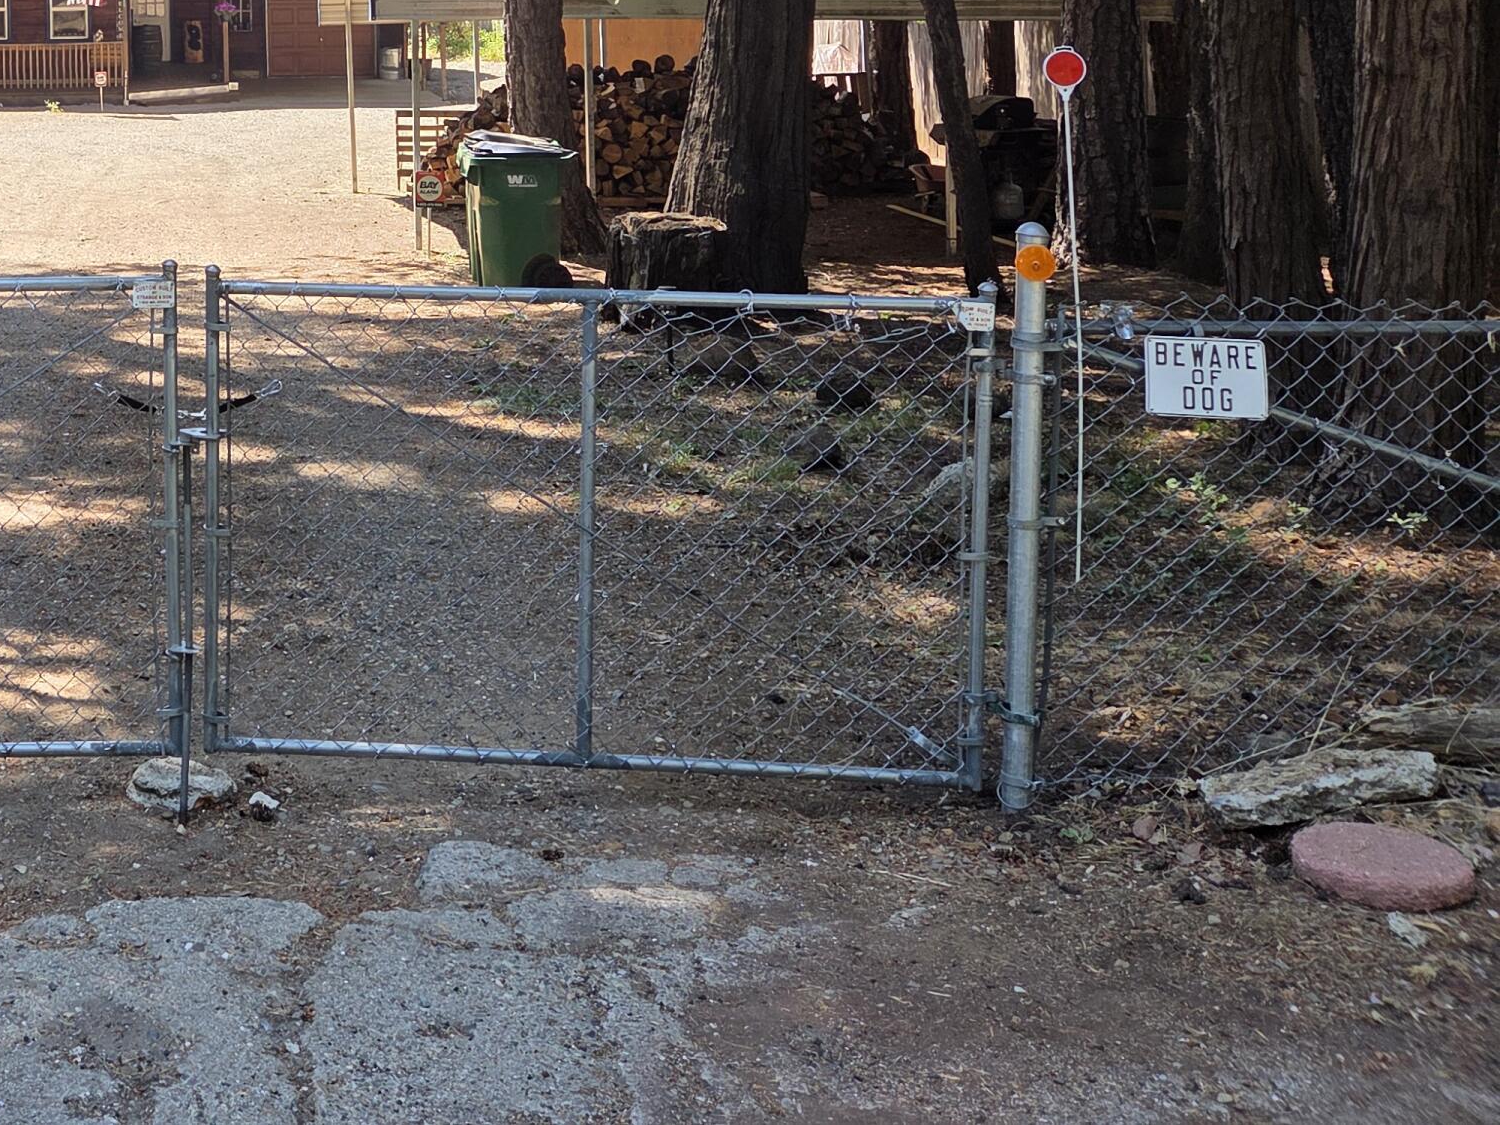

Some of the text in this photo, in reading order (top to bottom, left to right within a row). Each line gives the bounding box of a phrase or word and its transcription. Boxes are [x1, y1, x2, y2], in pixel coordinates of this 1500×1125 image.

[419, 181, 439, 189] BAY
[1155, 342, 1258, 370] BEWARE
[1192, 369, 1221, 385] OF
[1183, 386, 1232, 412] DOG
